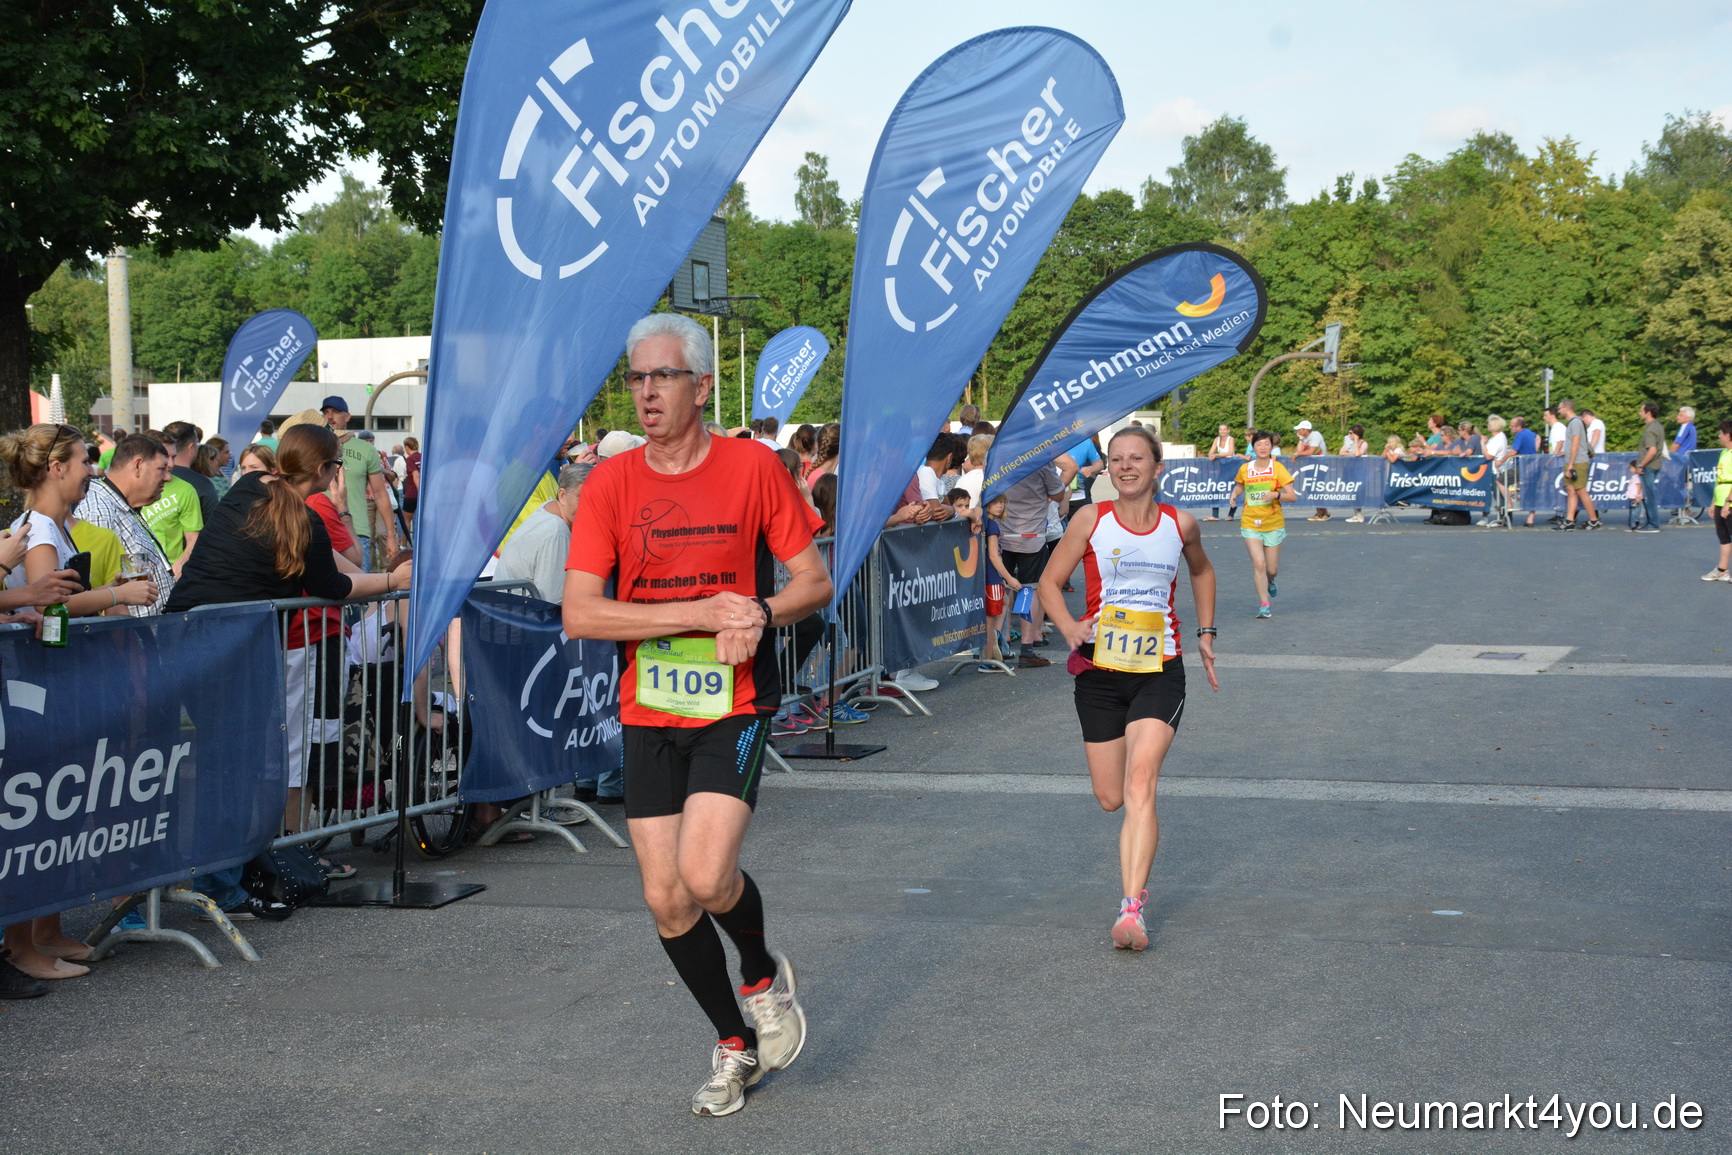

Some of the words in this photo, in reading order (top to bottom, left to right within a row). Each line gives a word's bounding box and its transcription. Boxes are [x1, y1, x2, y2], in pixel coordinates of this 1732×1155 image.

[632, 0, 795, 227] AUTOMOBILE
[920, 76, 1066, 295] Fischer
[972, 117, 1083, 291] AUTOMOBILE
[1134, 350, 1175, 379] Druck
[1175, 338, 1201, 356] und
[1201, 310, 1250, 344] Medien
[243, 325, 297, 399] Fischer
[261, 339, 303, 398] AUTOMOBILE
[771, 339, 813, 399] Fischer
[1028, 321, 1193, 421] Frischmann
[786, 349, 818, 398] AUTOMOBILE
[1174, 477, 1235, 493] Fischer
[1302, 477, 1362, 493] Fischer
[1389, 472, 1461, 488] Frischmann
[1692, 466, 1717, 483] Frisch
[1179, 493, 1231, 501] AUTOMOBILE
[1307, 493, 1357, 501] AUTOMOBILE
[1431, 487, 1448, 495] Druck
[1449, 488, 1462, 496] und
[1589, 493, 1629, 502] UTOMO
[651, 524, 715, 539] Physiotherapie
[717, 523, 738, 534] Wild
[1120, 561, 1166, 570] Physiotherapie
[1166, 564, 1176, 572] Wild
[650, 575, 696, 589] machen
[699, 573, 718, 585] Sie
[720, 571, 737, 584] fit!
[888, 567, 957, 609] Frischmann
[1149, 588, 1160, 597] Sie
[931, 602, 947, 622] Druck
[947, 602, 960, 618] und
[1104, 631, 1158, 656] 1112
[647, 665, 723, 695] 1109
[0, 738, 191, 831] scher
